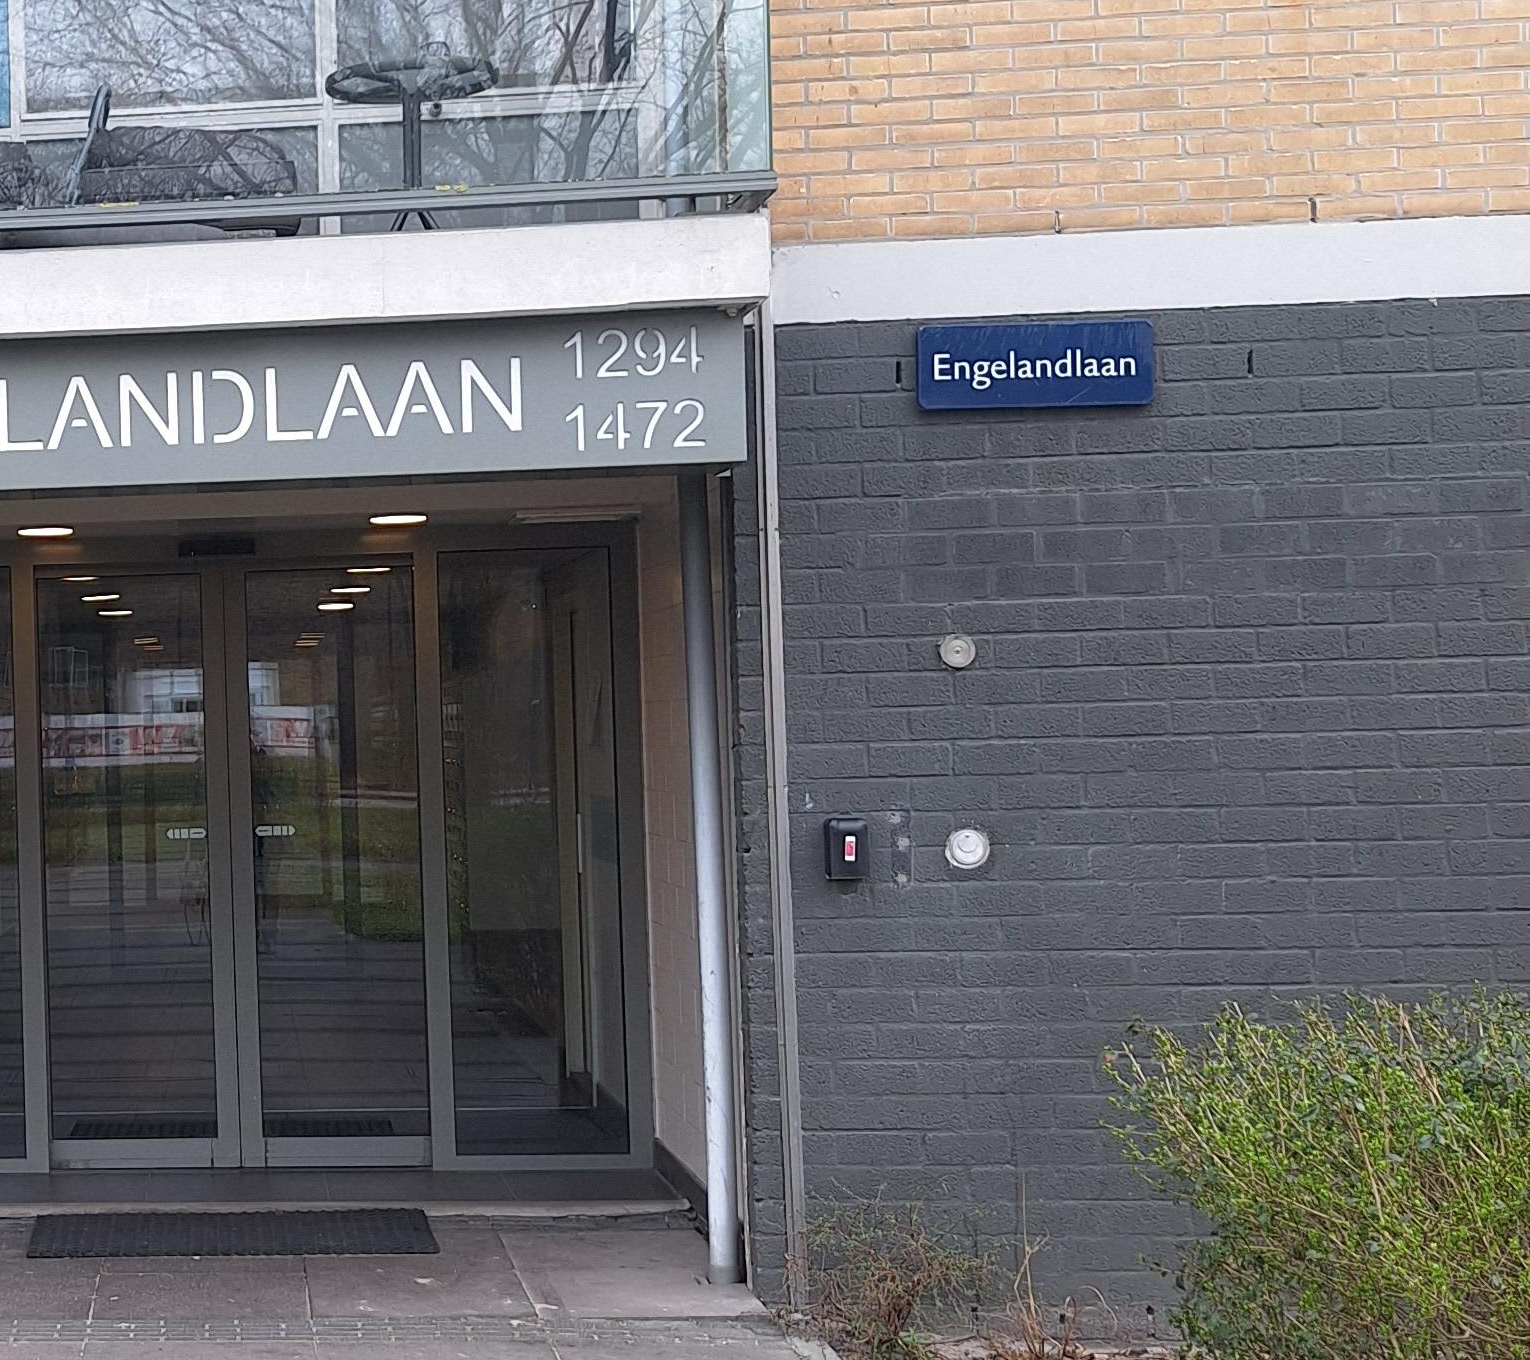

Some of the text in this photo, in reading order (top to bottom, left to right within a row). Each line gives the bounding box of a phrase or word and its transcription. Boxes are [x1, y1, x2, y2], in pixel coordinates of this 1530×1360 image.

[564, 326, 704, 380] 1294
[932, 348, 1137, 391] Engelandlaan
[565, 399, 707, 452] 1472
